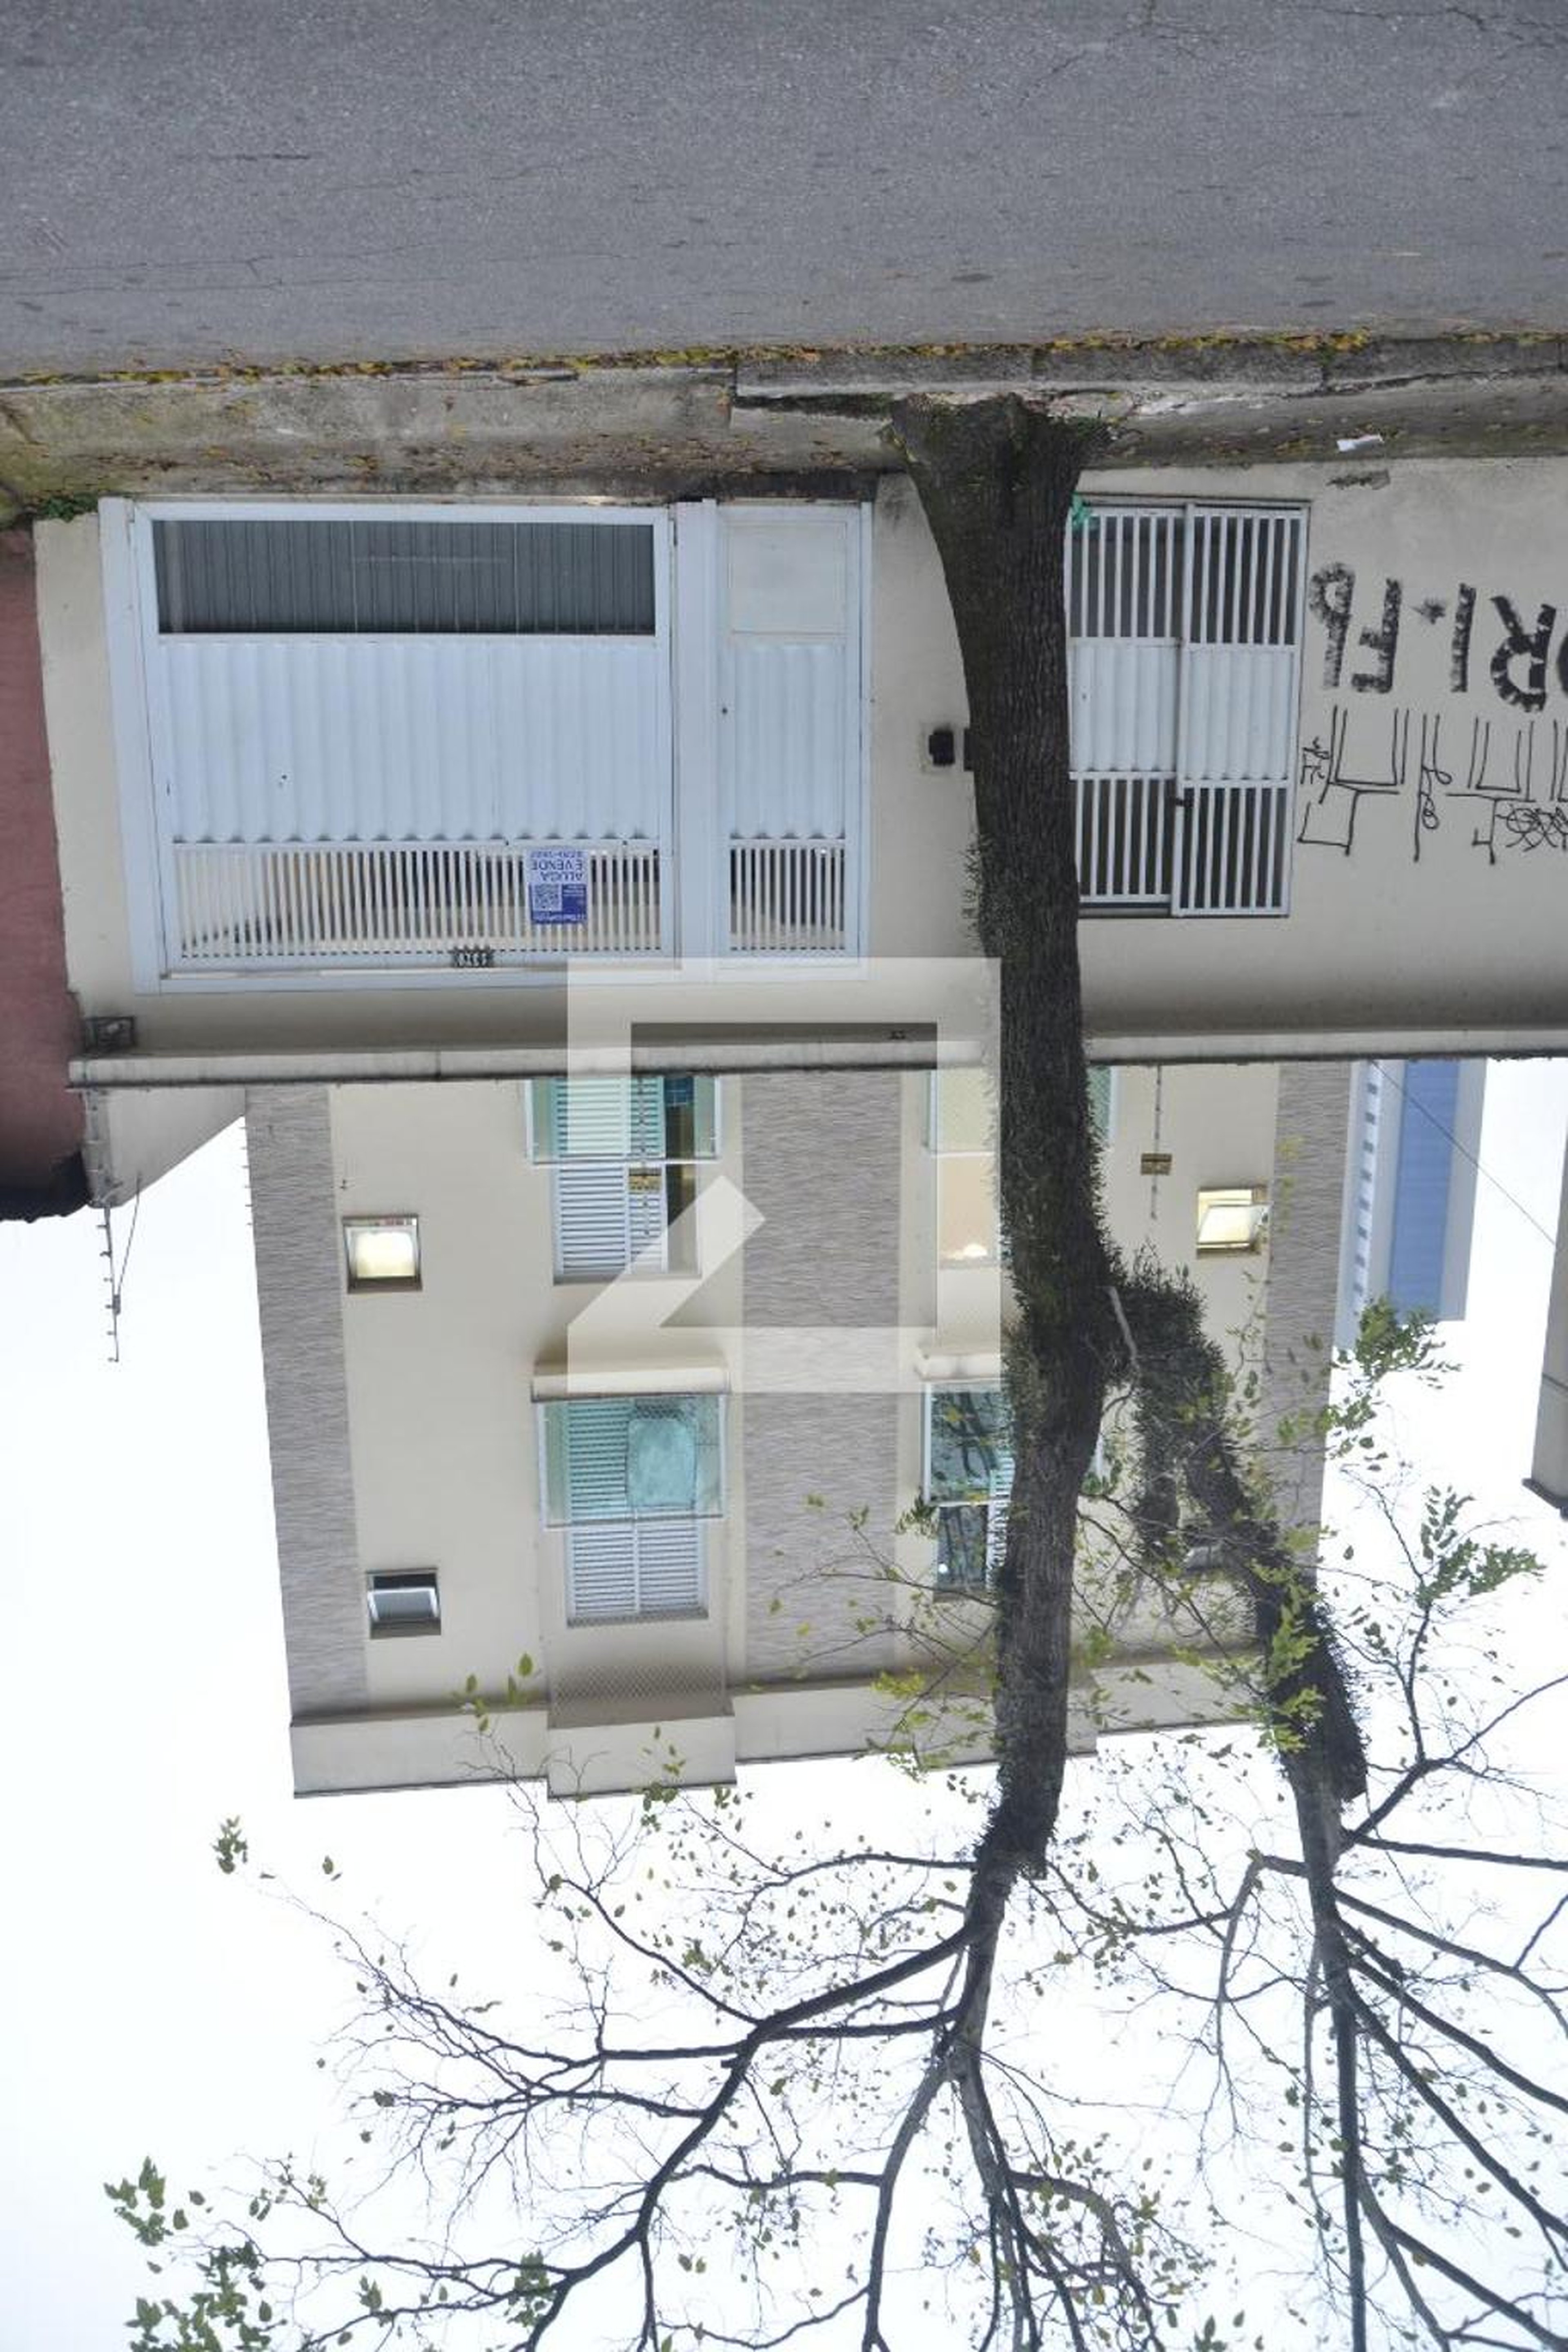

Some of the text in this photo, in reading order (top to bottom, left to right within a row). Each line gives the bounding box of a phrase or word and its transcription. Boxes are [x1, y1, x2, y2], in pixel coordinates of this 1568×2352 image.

[532, 859, 583, 871] E VENDE
[540, 871, 583, 881] ALUGA
